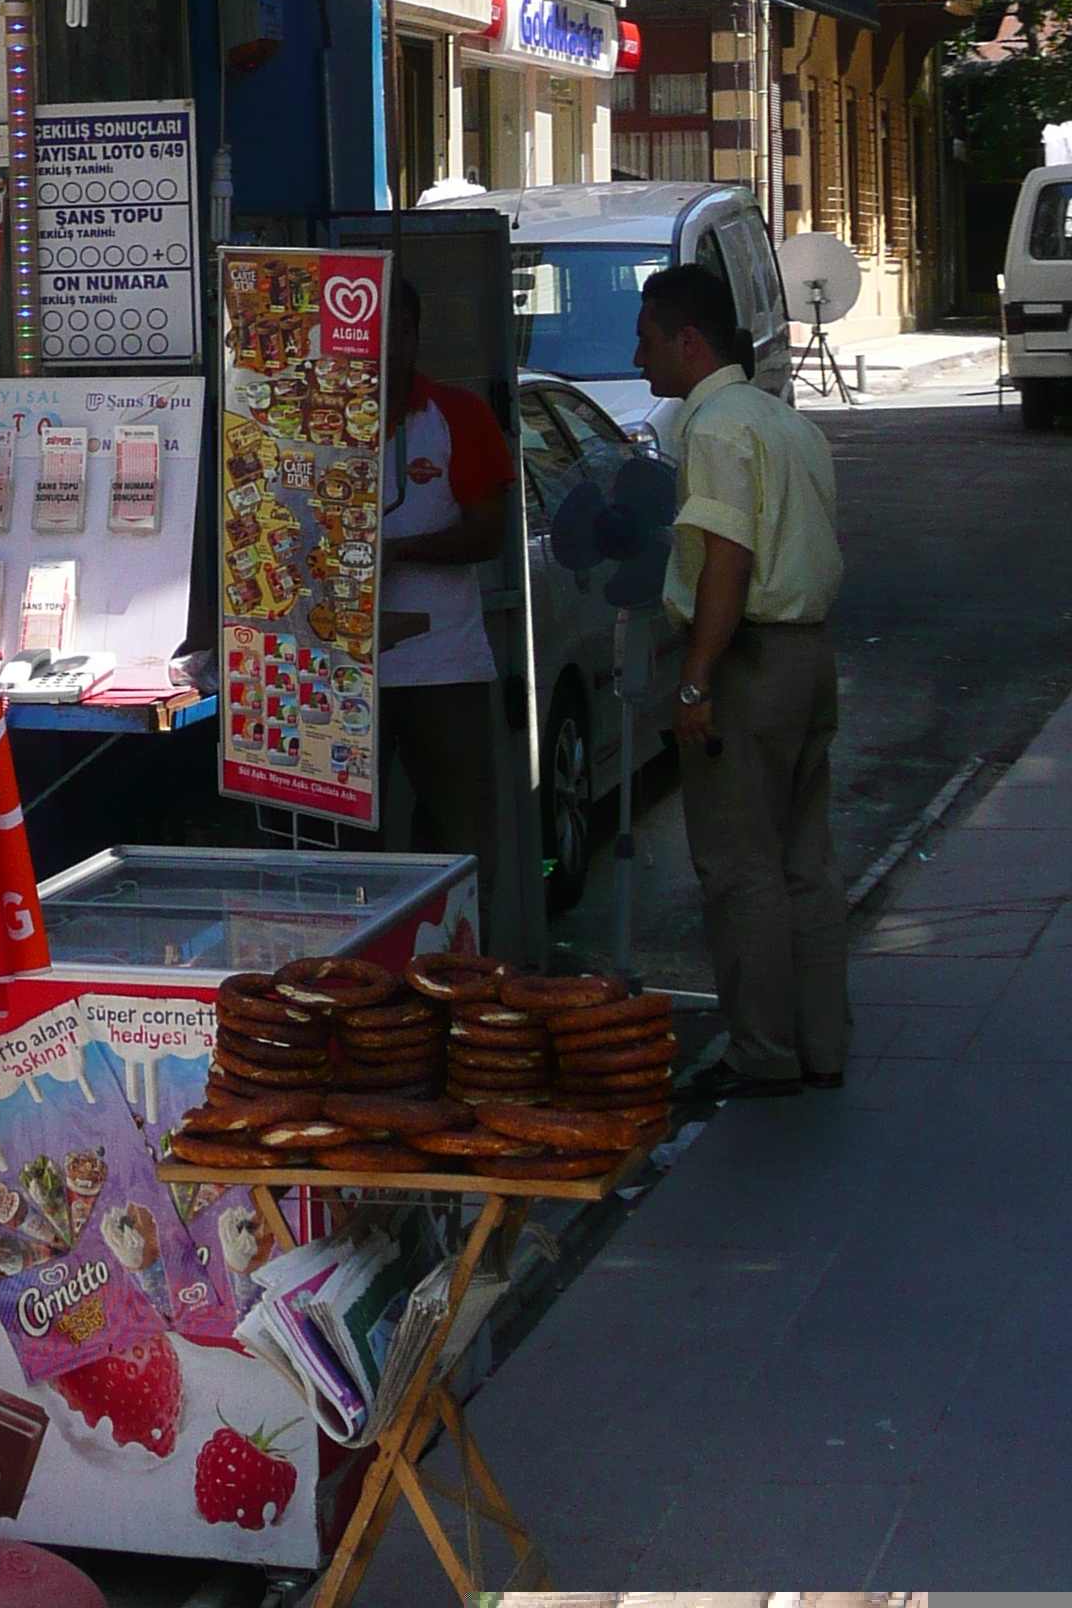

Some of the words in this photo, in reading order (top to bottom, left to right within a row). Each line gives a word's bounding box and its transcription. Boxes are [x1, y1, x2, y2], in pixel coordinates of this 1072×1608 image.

[94, 119, 182, 140] SONUÇLARI
[102, 144, 146, 161] LOTO
[149, 142, 184, 160] 6/49
[35, 165, 72, 177] EKİLİŞ
[55, 209, 105, 228] ŞANS
[111, 207, 164, 224] TOPU
[36, 229, 74, 241] EKİLİŞ
[52, 275, 81, 292] ON
[86, 274, 169, 291] NUMARA
[38, 295, 76, 306] EKİLİŞ
[106, 394, 144, 412] Şans
[283, 459, 314, 476] CARTE
[287, 473, 310, 487] D'OR
[86, 1005, 137, 1028] süper
[29, 1014, 79, 1048] alana
[111, 1023, 188, 1050] hediyesi
[17, 1260, 109, 1337] Cornetto
